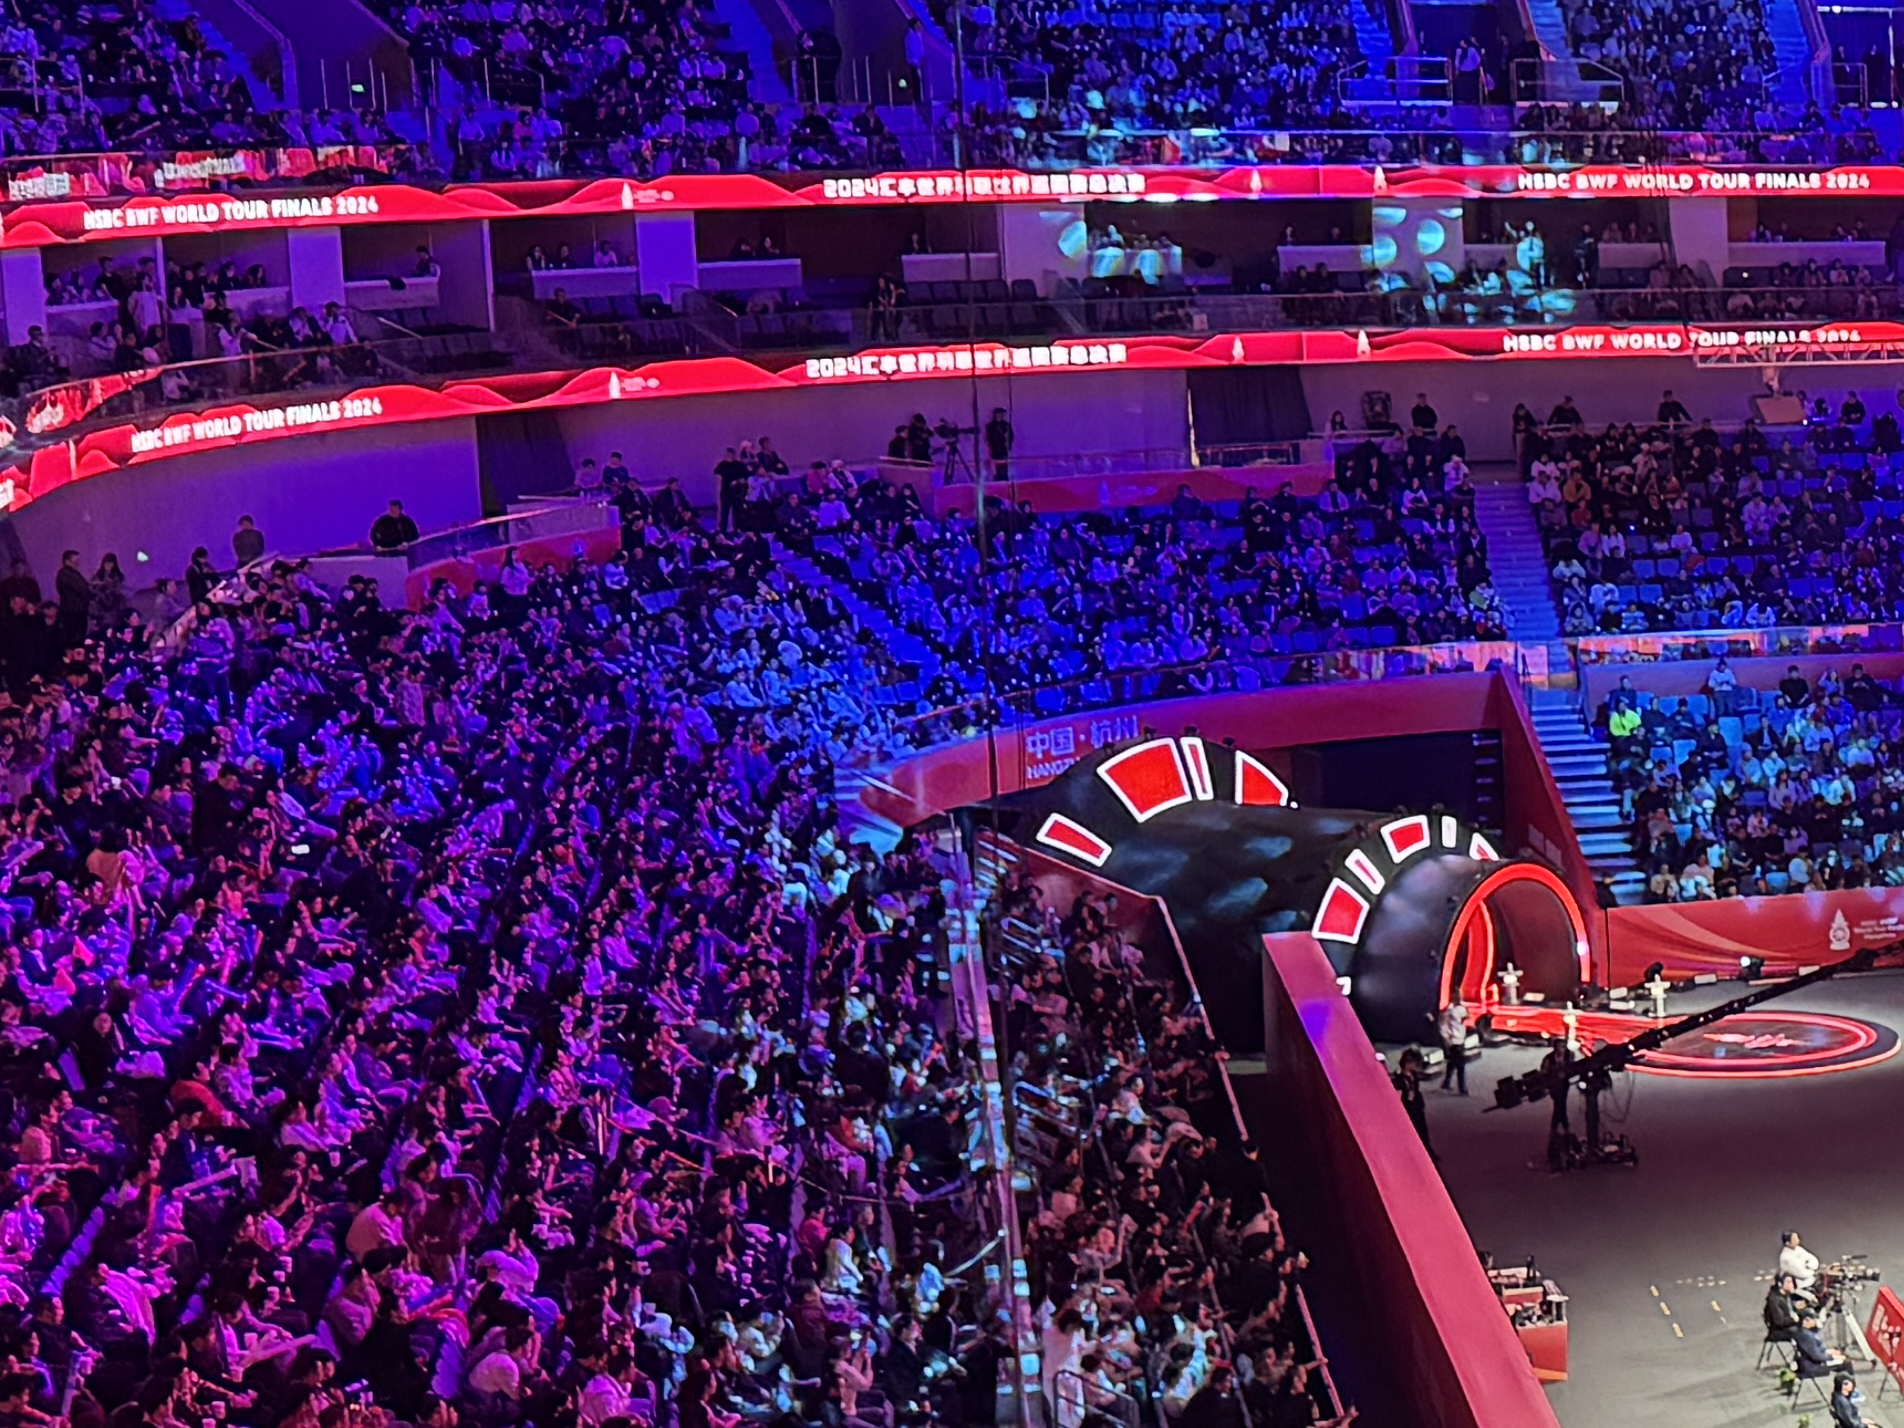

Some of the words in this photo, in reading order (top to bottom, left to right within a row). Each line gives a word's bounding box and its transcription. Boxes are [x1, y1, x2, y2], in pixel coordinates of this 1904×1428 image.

[1517, 173, 1570, 190] HSBC
[1576, 173, 1618, 190] BWF
[1624, 172, 1693, 190] WORLD
[1699, 172, 1751, 190] TOUR
[1755, 172, 1821, 190] FINALS
[1826, 173, 1870, 190] 2024
[84, 207, 124, 230] HSBC
[162, 202, 220, 225] WORLD
[222, 199, 269, 222] TOUR
[271, 196, 334, 218] FINALS
[336, 194, 379, 216] 2024
[1503, 334, 1556, 353] HSBC
[1562, 334, 1606, 352] BWF
[1609, 332, 1682, 351] WORLD
[192, 416, 242, 440] WORLD
[243, 409, 286, 432] TOUR
[285, 400, 342, 427] FINALS
[343, 396, 384, 419] 2024
